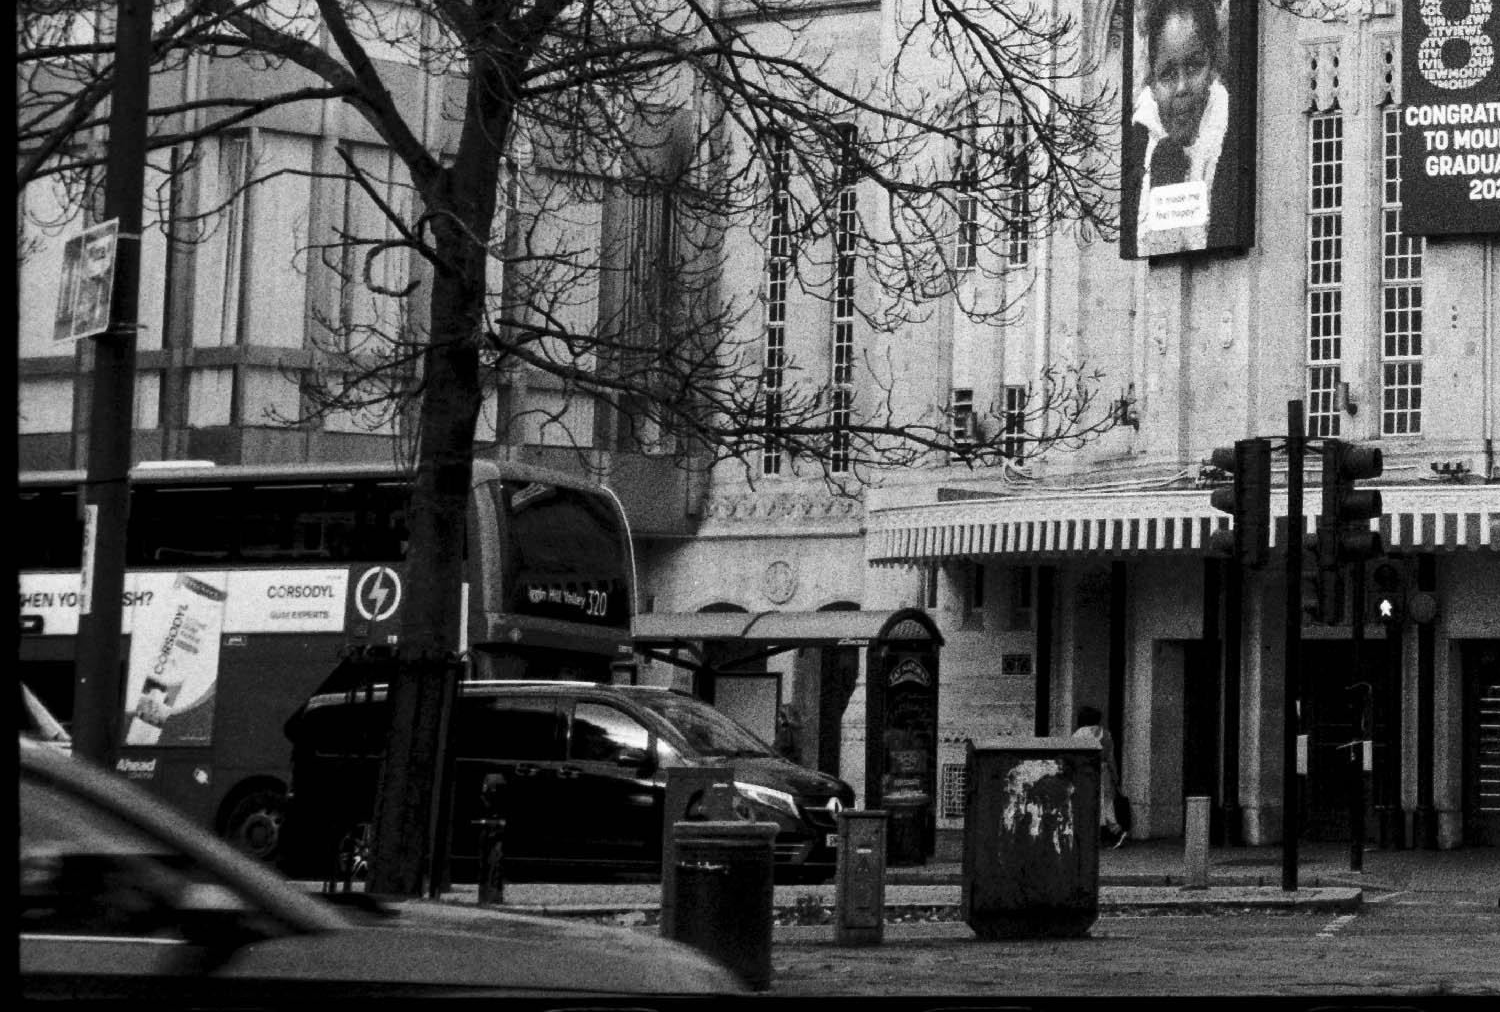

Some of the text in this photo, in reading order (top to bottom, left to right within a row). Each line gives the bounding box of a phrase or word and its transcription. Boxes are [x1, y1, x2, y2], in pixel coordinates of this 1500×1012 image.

[1424, 130, 1448, 151] TO
[20, 593, 54, 608] HEN
[267, 585, 335, 599] CORSODYL
[586, 589, 608, 616] 320
[154, 603, 189, 675] CORSODYL
